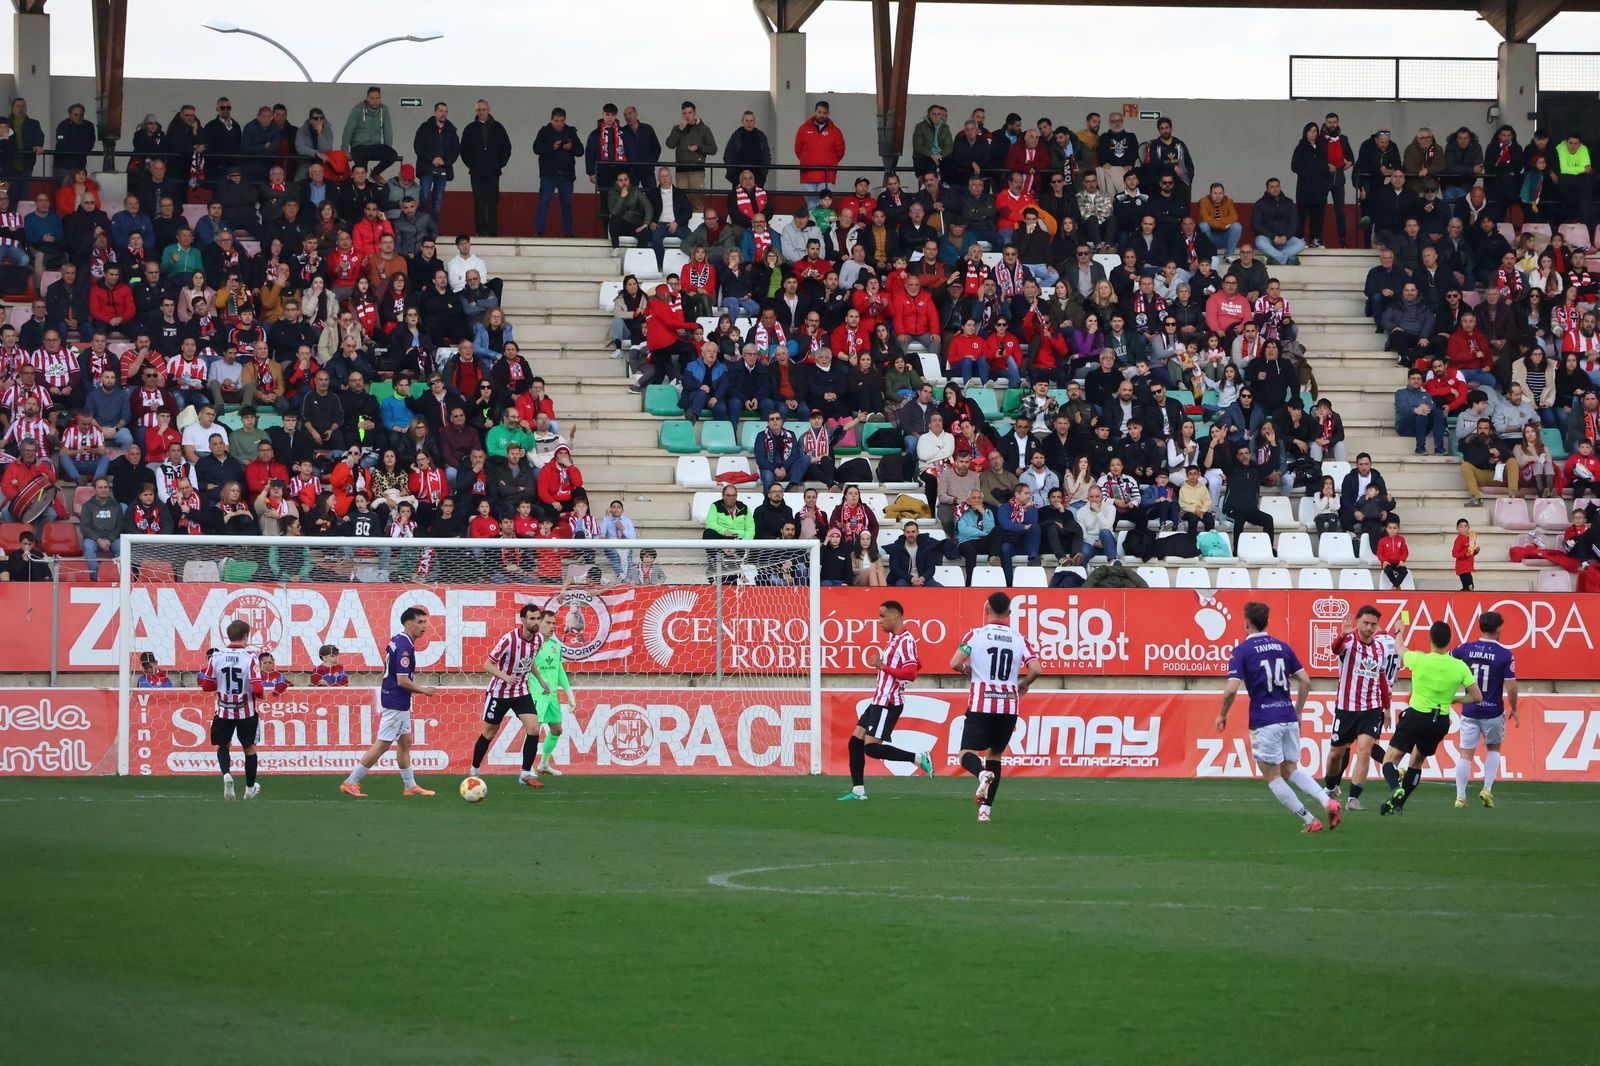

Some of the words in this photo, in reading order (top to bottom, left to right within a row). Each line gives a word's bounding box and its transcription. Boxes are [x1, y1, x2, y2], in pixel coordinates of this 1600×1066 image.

[355, 521, 370, 536] 80
[565, 593, 593, 603] ONDO
[390, 589, 496, 668] CF
[667, 616, 809, 643] CENTRO
[820, 610, 946, 644] ÓPTCO
[1376, 598, 1594, 650] ZAMORA
[731, 644, 884, 669] ROBERTO
[987, 646, 1014, 681] 10
[1027, 631, 1130, 668] eadapt
[221, 667, 243, 694] 15
[1163, 661, 1211, 672] PODOLOGÍA
[1260, 658, 1289, 693] 14
[1471, 663, 1490, 692] 11
[490, 701, 498, 712] 2
[171, 704, 439, 748] Smillr
[947, 715, 1161, 755] RIMAY
[1059, 757, 1159, 768] CLIMATIZACION
